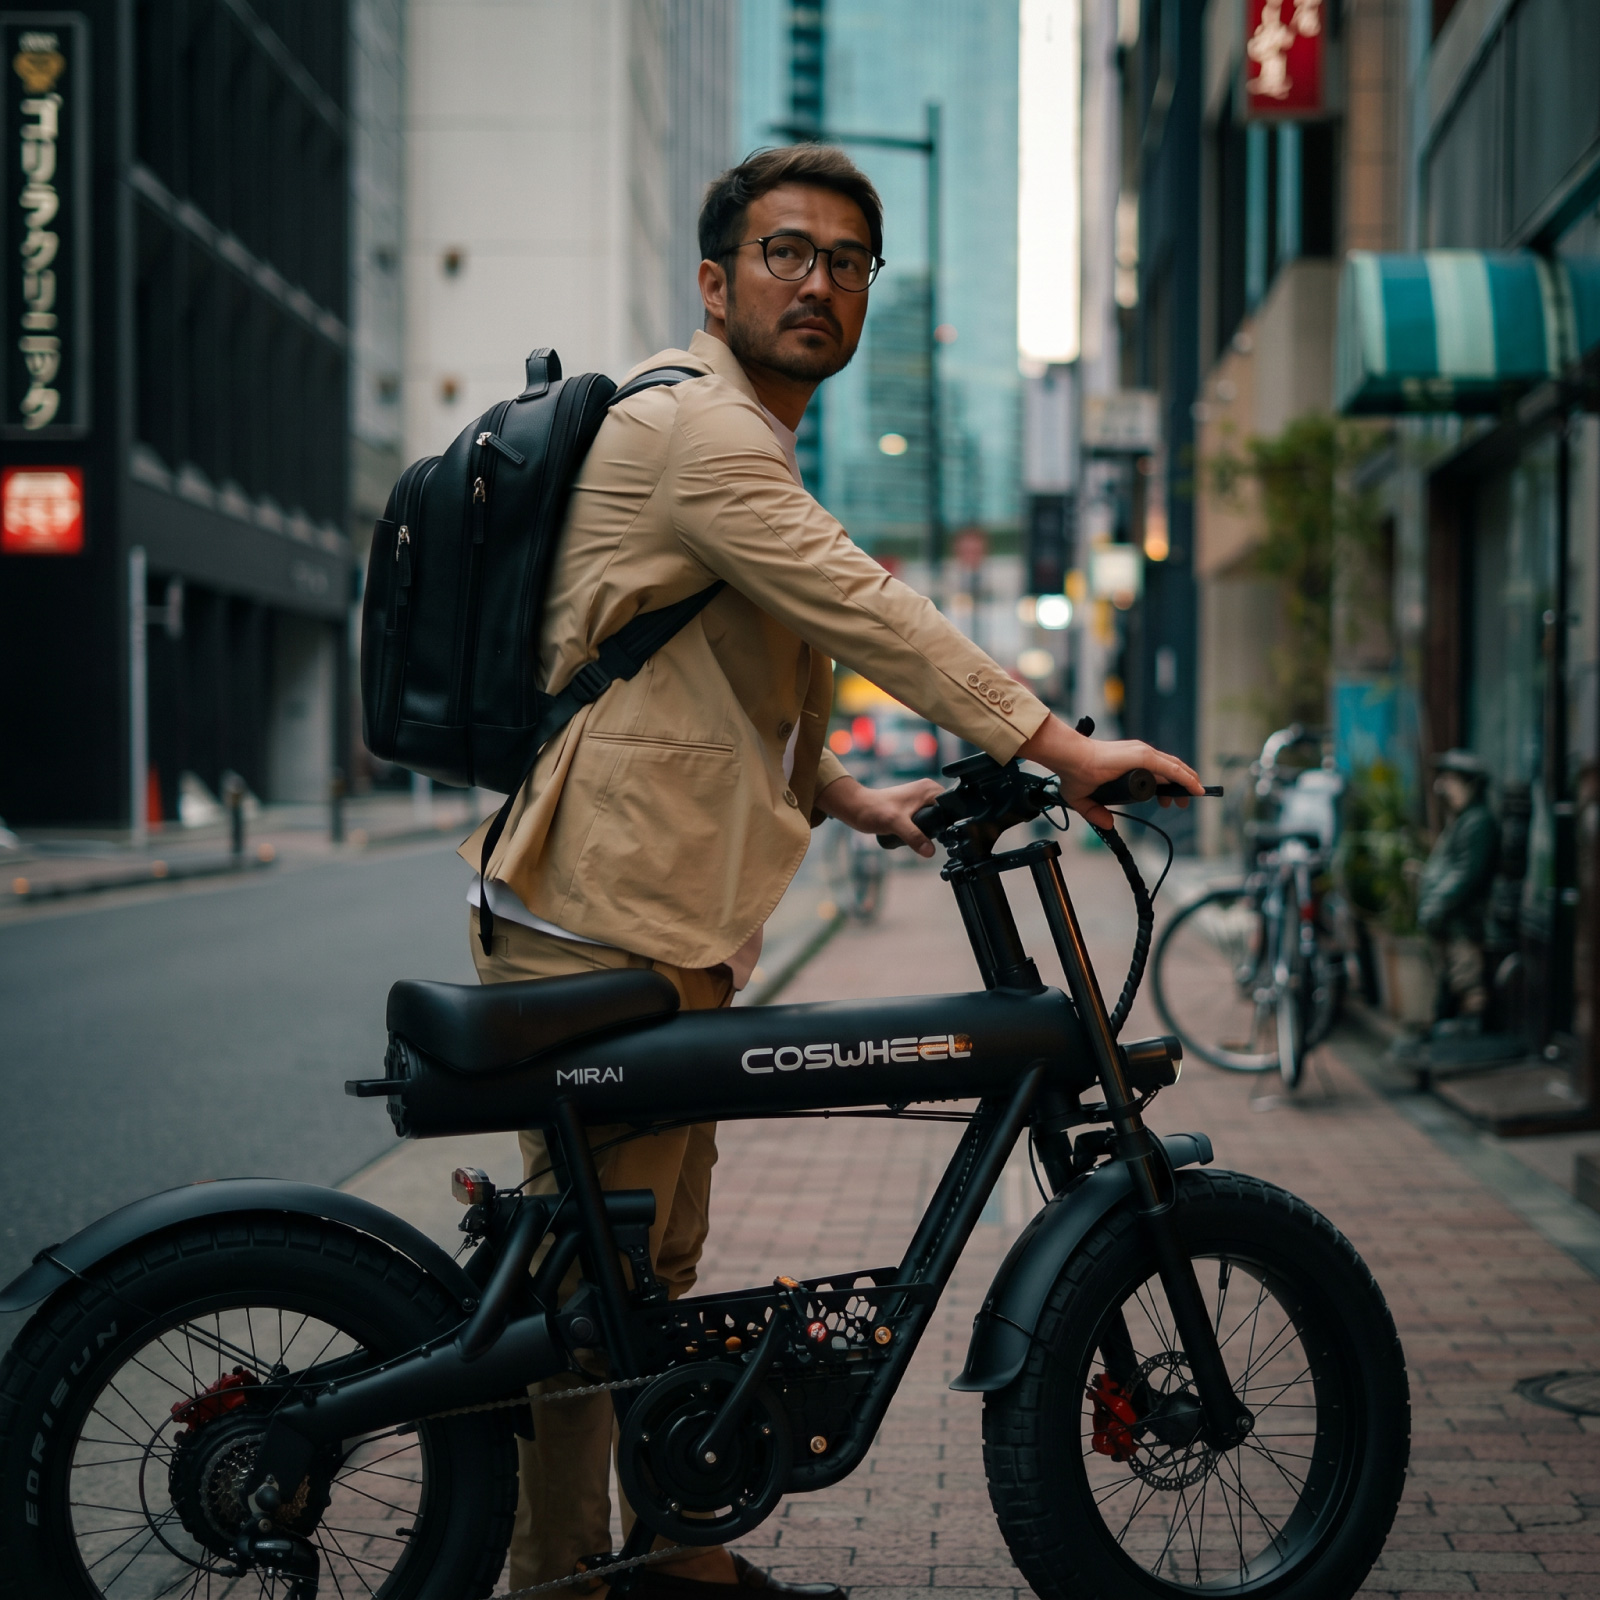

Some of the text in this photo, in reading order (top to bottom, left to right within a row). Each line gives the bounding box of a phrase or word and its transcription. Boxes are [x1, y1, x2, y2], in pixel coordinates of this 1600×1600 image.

[20, 94, 62, 430] ゴリラクリニック
[556, 1066, 624, 1087] MIRAI
[741, 1034, 971, 1075] COSWHEEL
[25, 1320, 119, 1527] EORISUN
